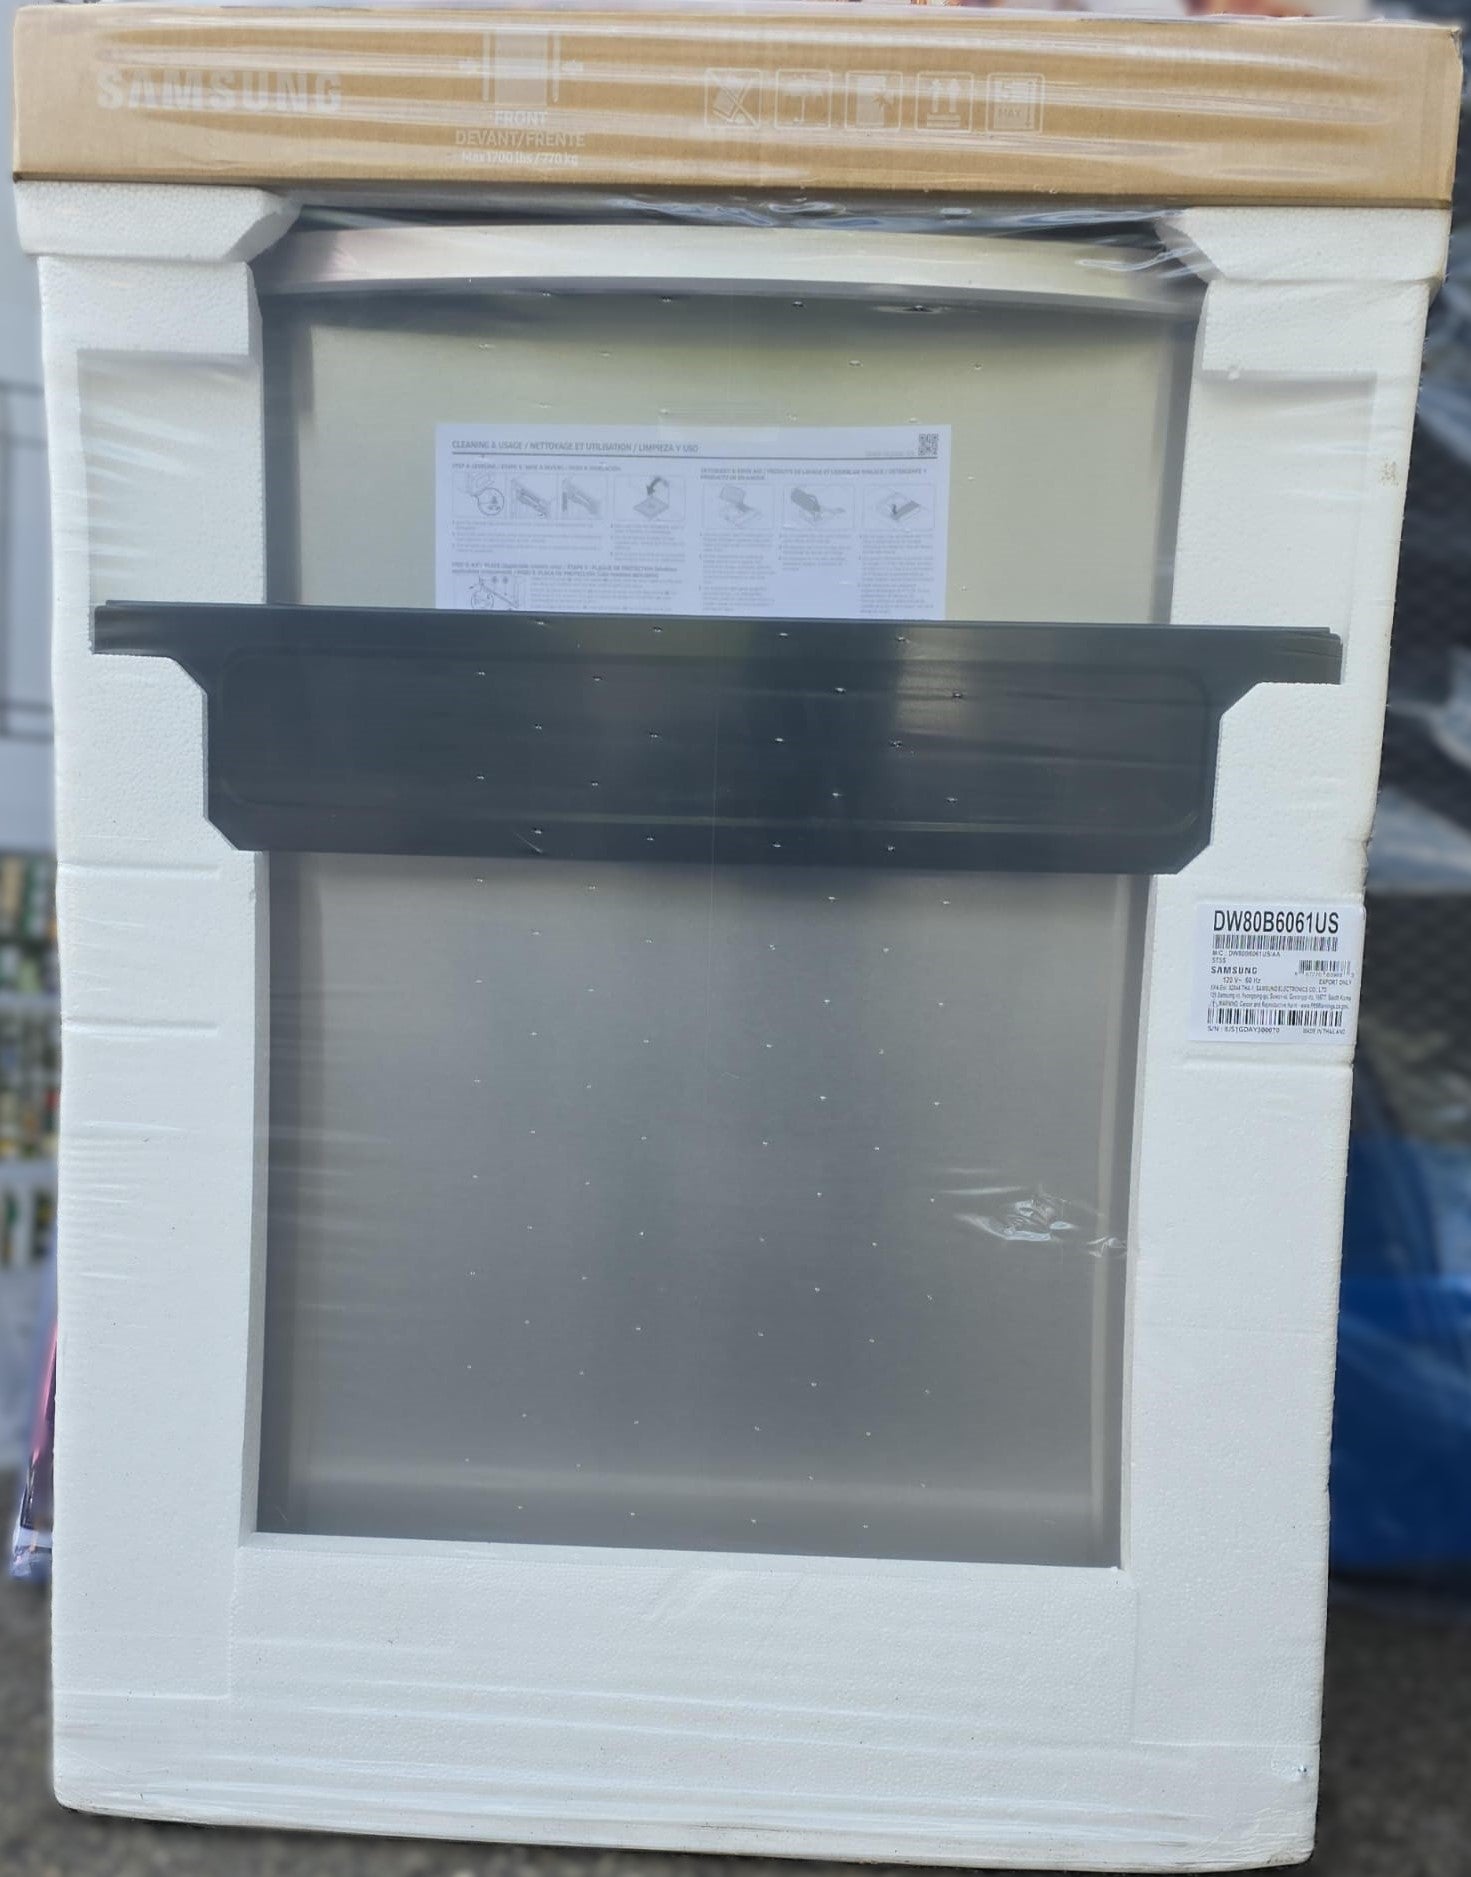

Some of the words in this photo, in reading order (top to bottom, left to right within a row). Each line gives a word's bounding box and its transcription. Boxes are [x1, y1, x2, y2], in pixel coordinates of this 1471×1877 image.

[97, 69, 341, 113] SAMSUNG
[495, 110, 547, 125] FRONT
[455, 129, 586, 147] DEVANT/FRENTE
[451, 440, 489, 449] CLEANING
[499, 441, 522, 449] USAGE
[530, 441, 574, 451] NETTOYAGE
[639, 443, 673, 452] LIMPIEZA
[1213, 910, 1339, 934] DW80B6061US
[1210, 966, 1258, 974] SAMSUNG
